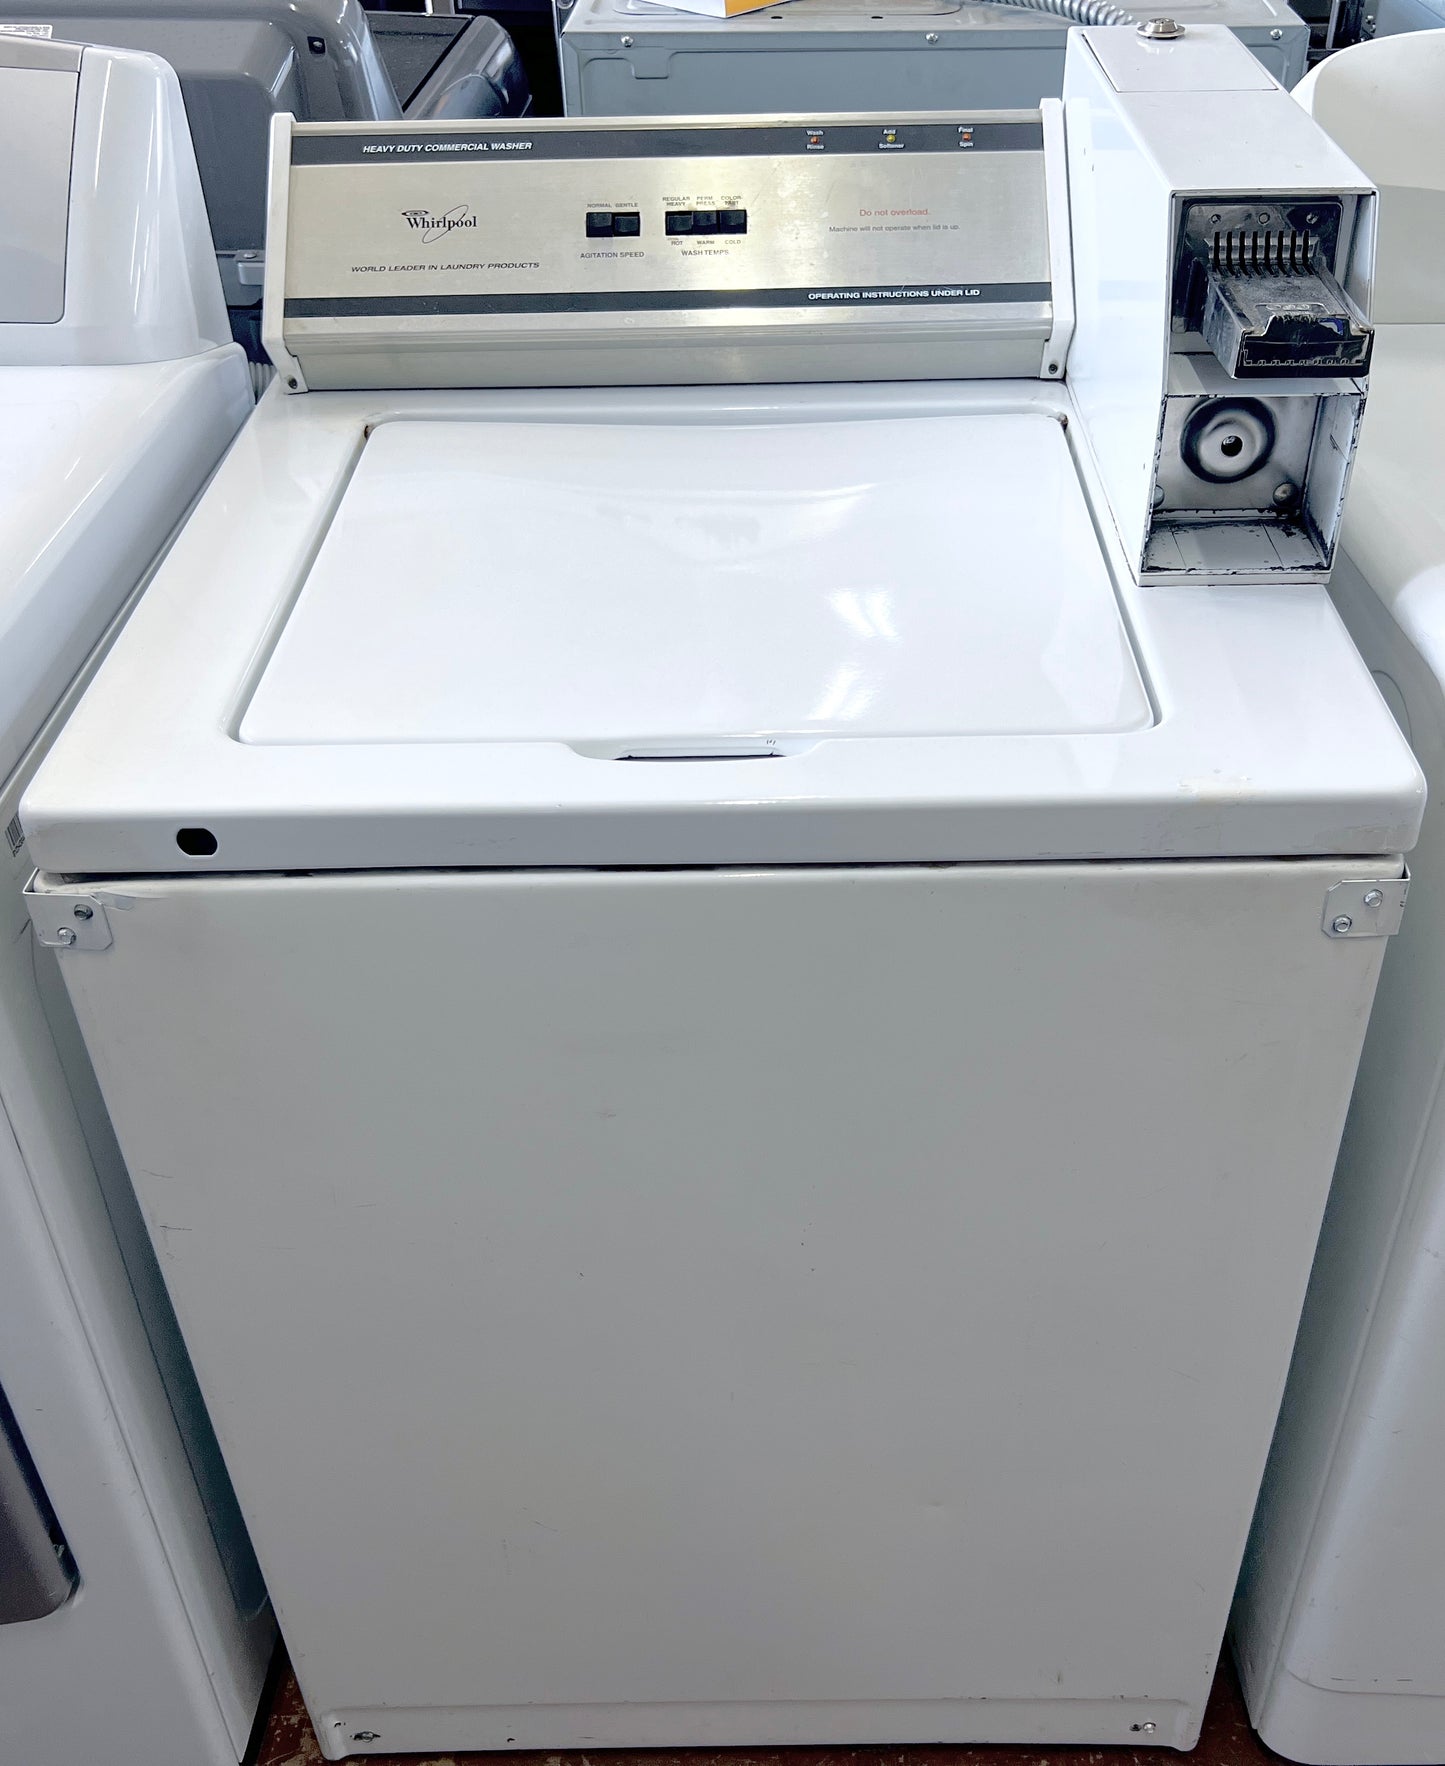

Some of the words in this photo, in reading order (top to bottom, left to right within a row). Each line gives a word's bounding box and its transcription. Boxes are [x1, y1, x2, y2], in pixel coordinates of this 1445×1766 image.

[362, 145, 396, 153] HEAVY
[396, 144, 424, 153] DUTY
[424, 143, 489, 152] COMMERCIAL
[490, 142, 533, 151] WASHER
[406, 215, 477, 231] Whirlpool
[351, 265, 386, 273] WORLD
[388, 264, 426, 272] LEADER
[440, 263, 485, 271] LAUNDRY
[808, 292, 860, 300] OPERATING
[862, 290, 930, 298] INSTRUCTIONS
[931, 289, 963, 297] UNDER
